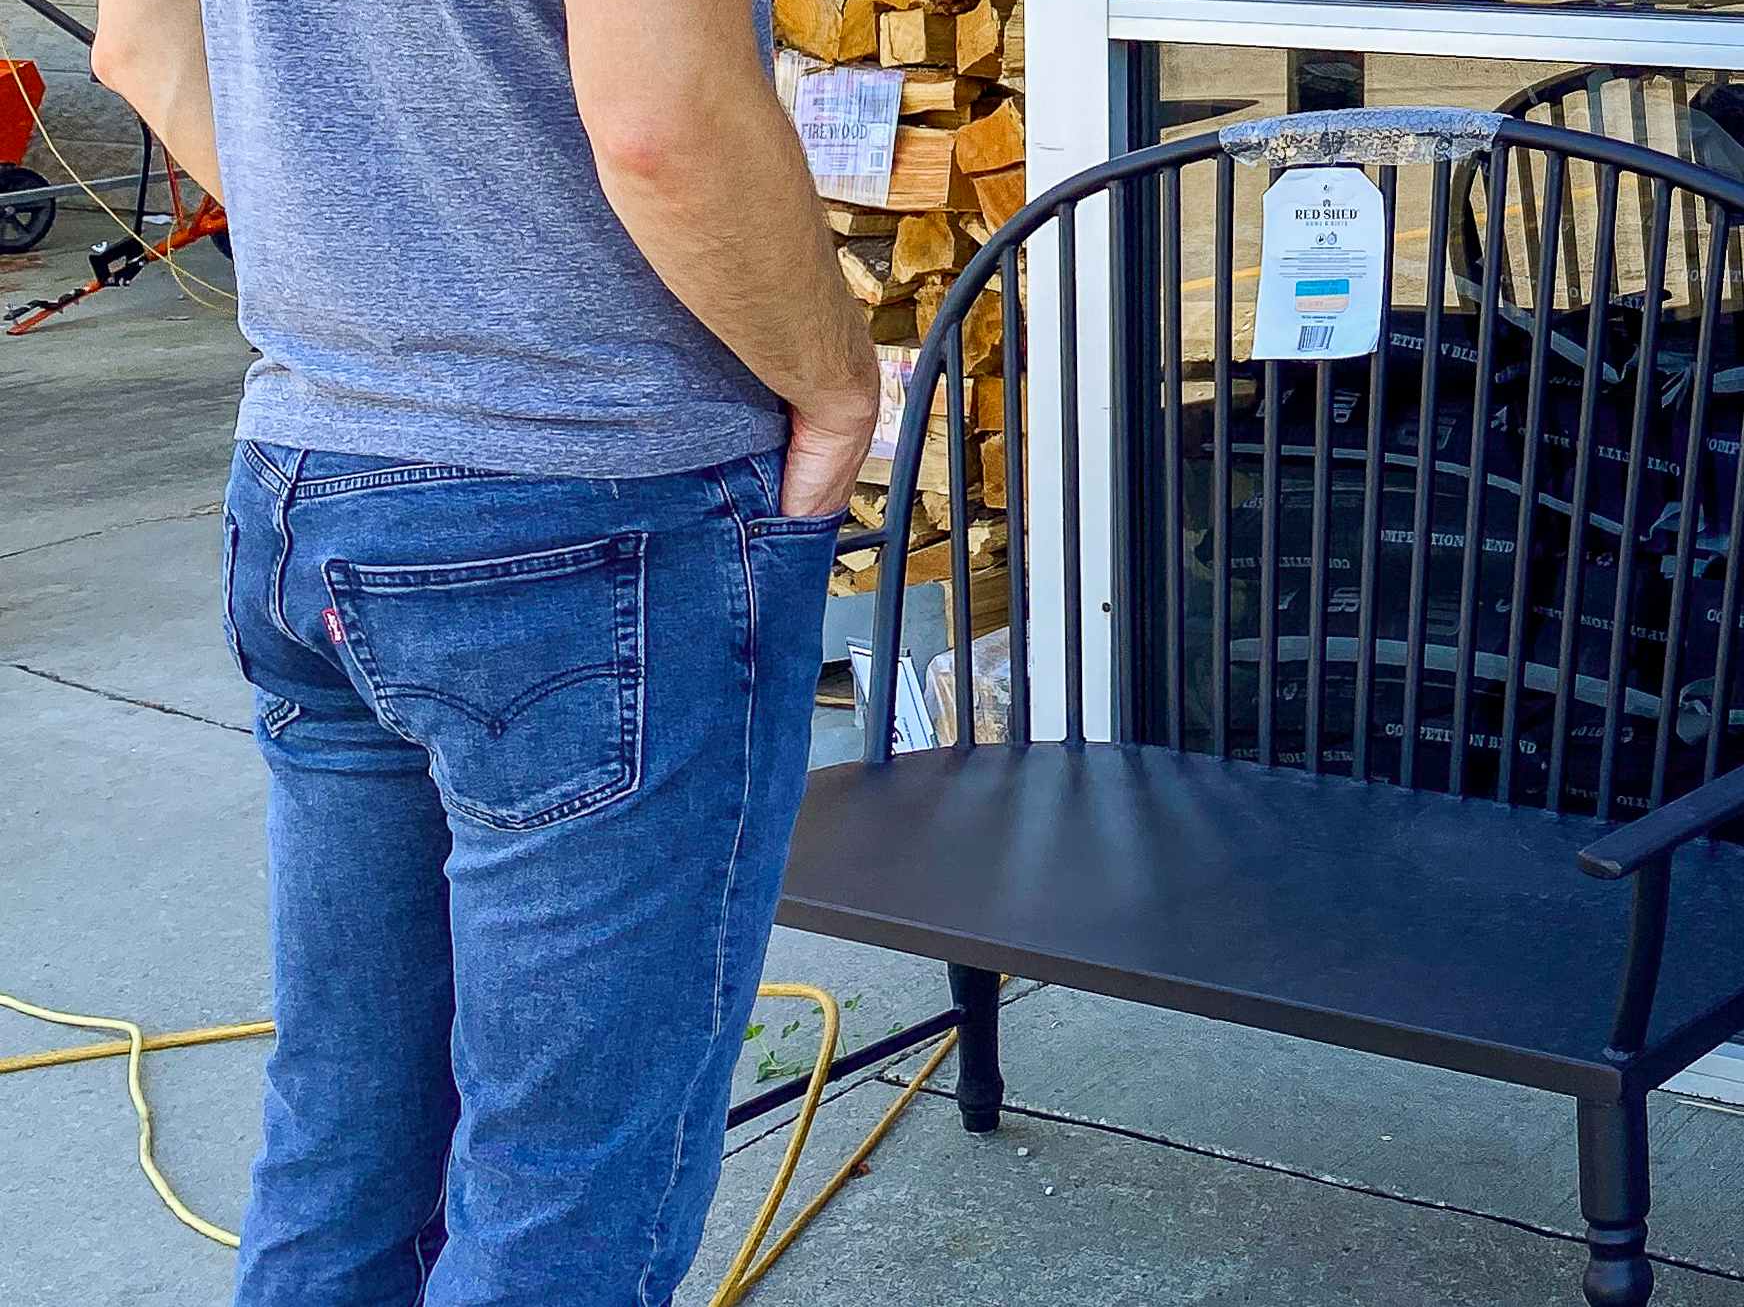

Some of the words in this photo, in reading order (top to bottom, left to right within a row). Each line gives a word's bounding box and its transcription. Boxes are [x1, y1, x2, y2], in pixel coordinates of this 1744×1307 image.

[802, 122, 868, 140] FIREWOOD
[1295, 208, 1321, 221] RED
[1323, 208, 1358, 221] SHED
